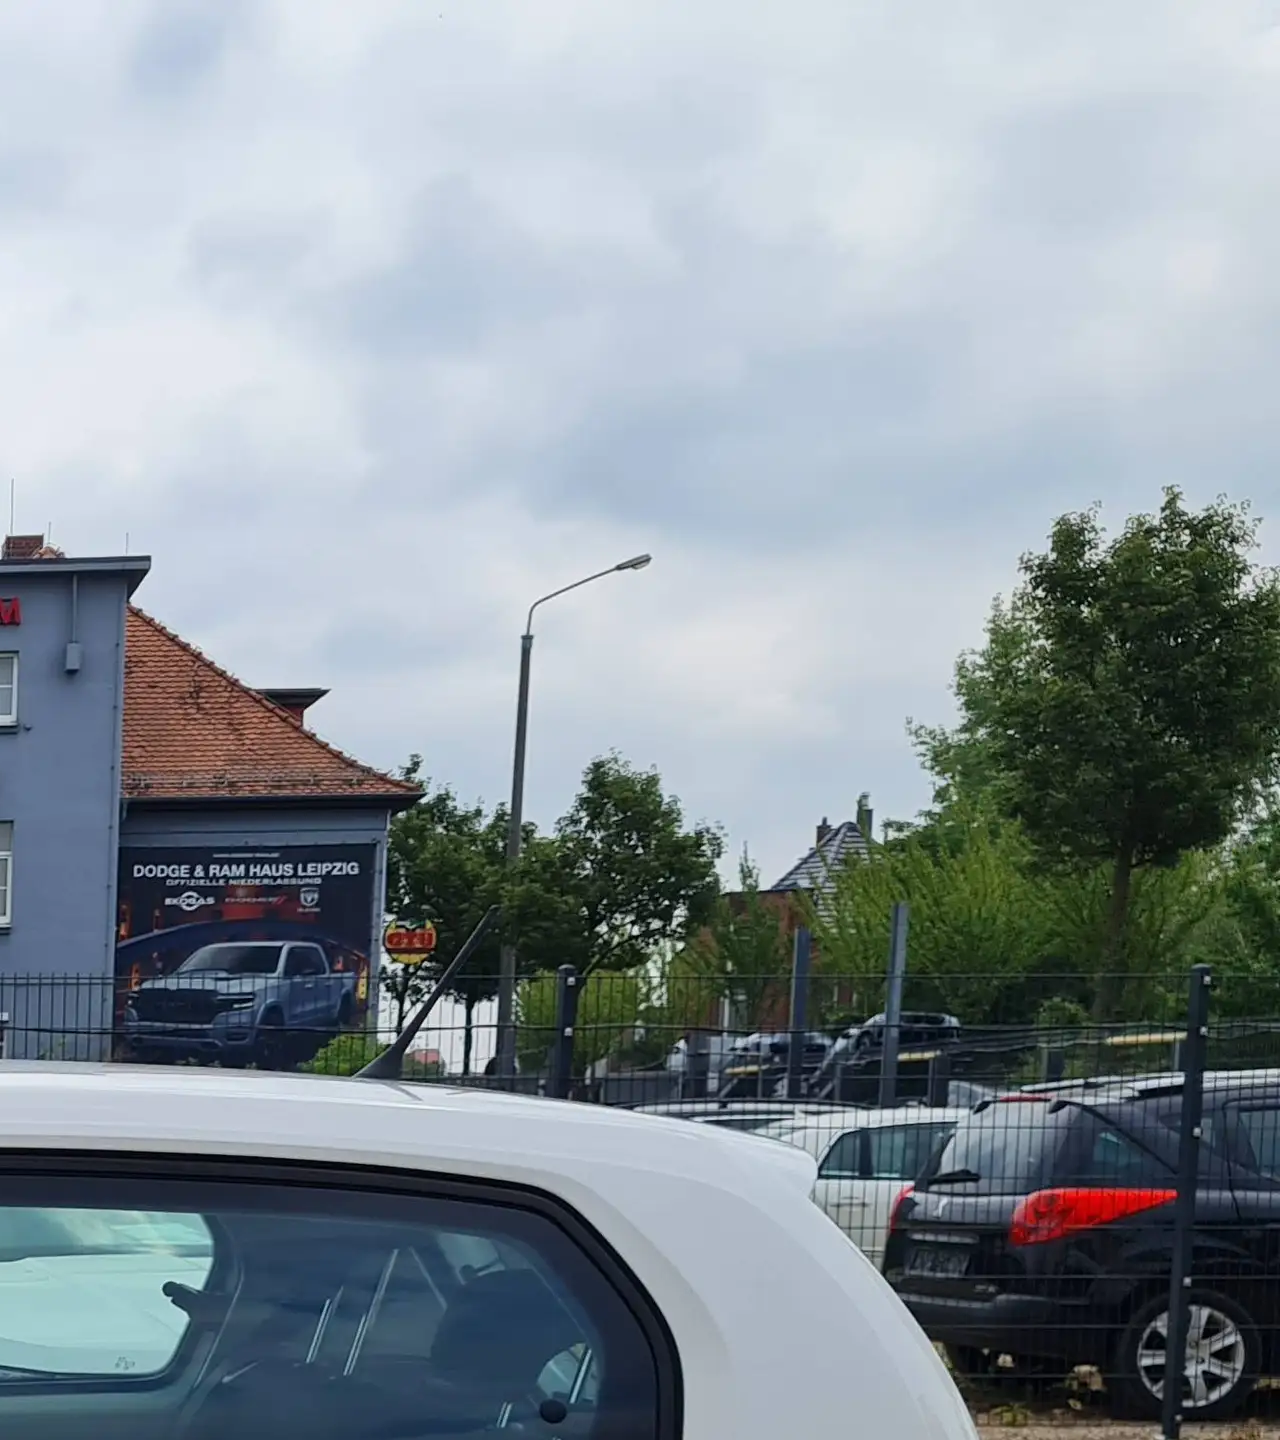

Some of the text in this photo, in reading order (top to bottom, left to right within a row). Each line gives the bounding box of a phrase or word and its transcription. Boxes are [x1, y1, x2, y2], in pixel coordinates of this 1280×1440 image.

[133, 862, 360, 878] DODGE & RAM HAUS LEIPZIG
